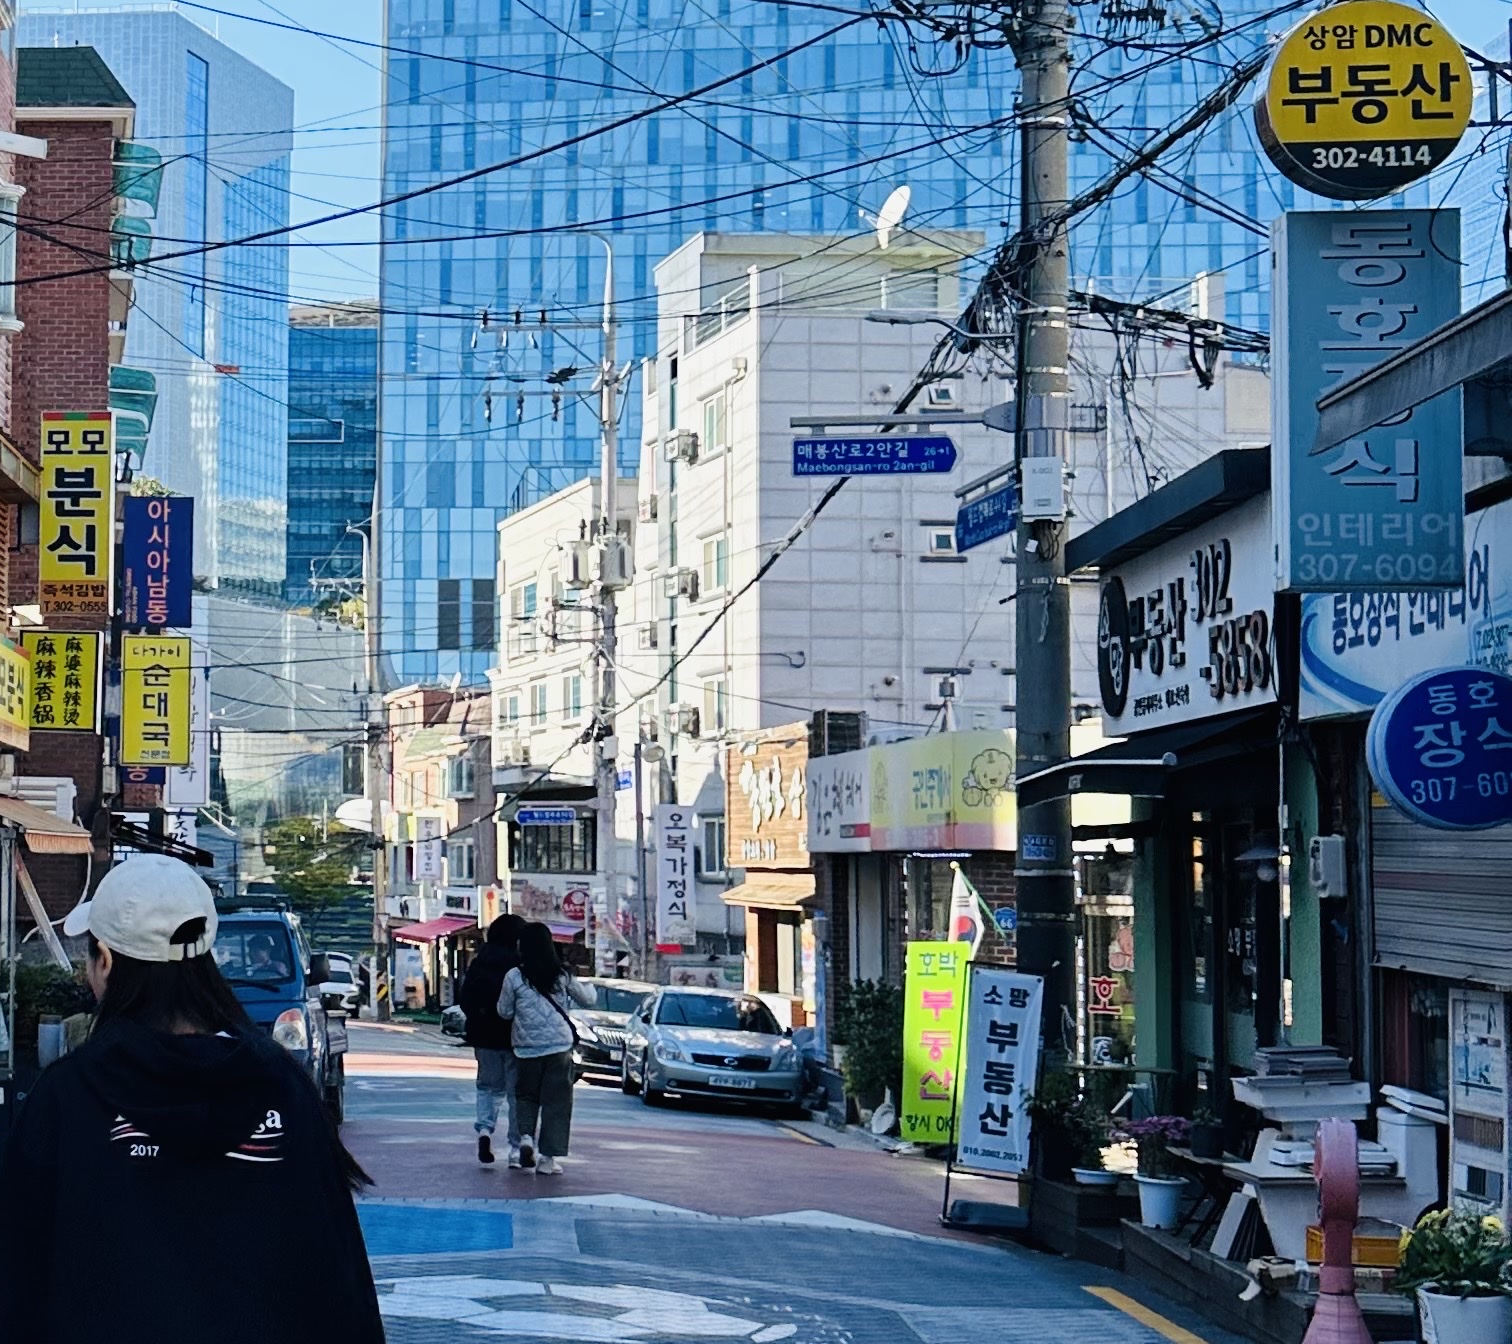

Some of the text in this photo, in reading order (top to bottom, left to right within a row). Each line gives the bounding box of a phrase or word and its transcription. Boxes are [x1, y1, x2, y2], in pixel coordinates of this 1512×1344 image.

[1304, 22, 1434, 51] 상암 DMC
[1281, 61, 1461, 125] 부동산
[1311, 144, 1433, 170] 302-4114
[1318, 221, 1426, 504] 동호식
[43, 429, 109, 456] 모모
[796, 441, 910, 461] 매봉산로2안길
[796, 459, 936, 474] Maebongsan-ro 2an-gil
[46, 466, 103, 577] 분식
[1296, 511, 1458, 548] 인테리어
[1190, 537, 1234, 624] 302
[1298, 552, 1460, 583] 307-6094
[41, 582, 107, 598] 즉석김밥
[1128, 576, 1188, 677] 부동산
[32, 635, 57, 725] 麻辣香锅
[1427, 679, 1499, 717] 동호
[141, 663, 172, 747] 순대국
[664, 812, 688, 921] 오복가정식
[916, 950, 959, 978] 호박
[983, 984, 1031, 1010] 소망
[1089, 976, 1123, 1014] 호
[919, 989, 955, 1103] 부동산
[977, 1019, 1020, 1138] 부동산
[905, 1113, 931, 1134] 항시
[130, 1143, 160, 1158] 2017
